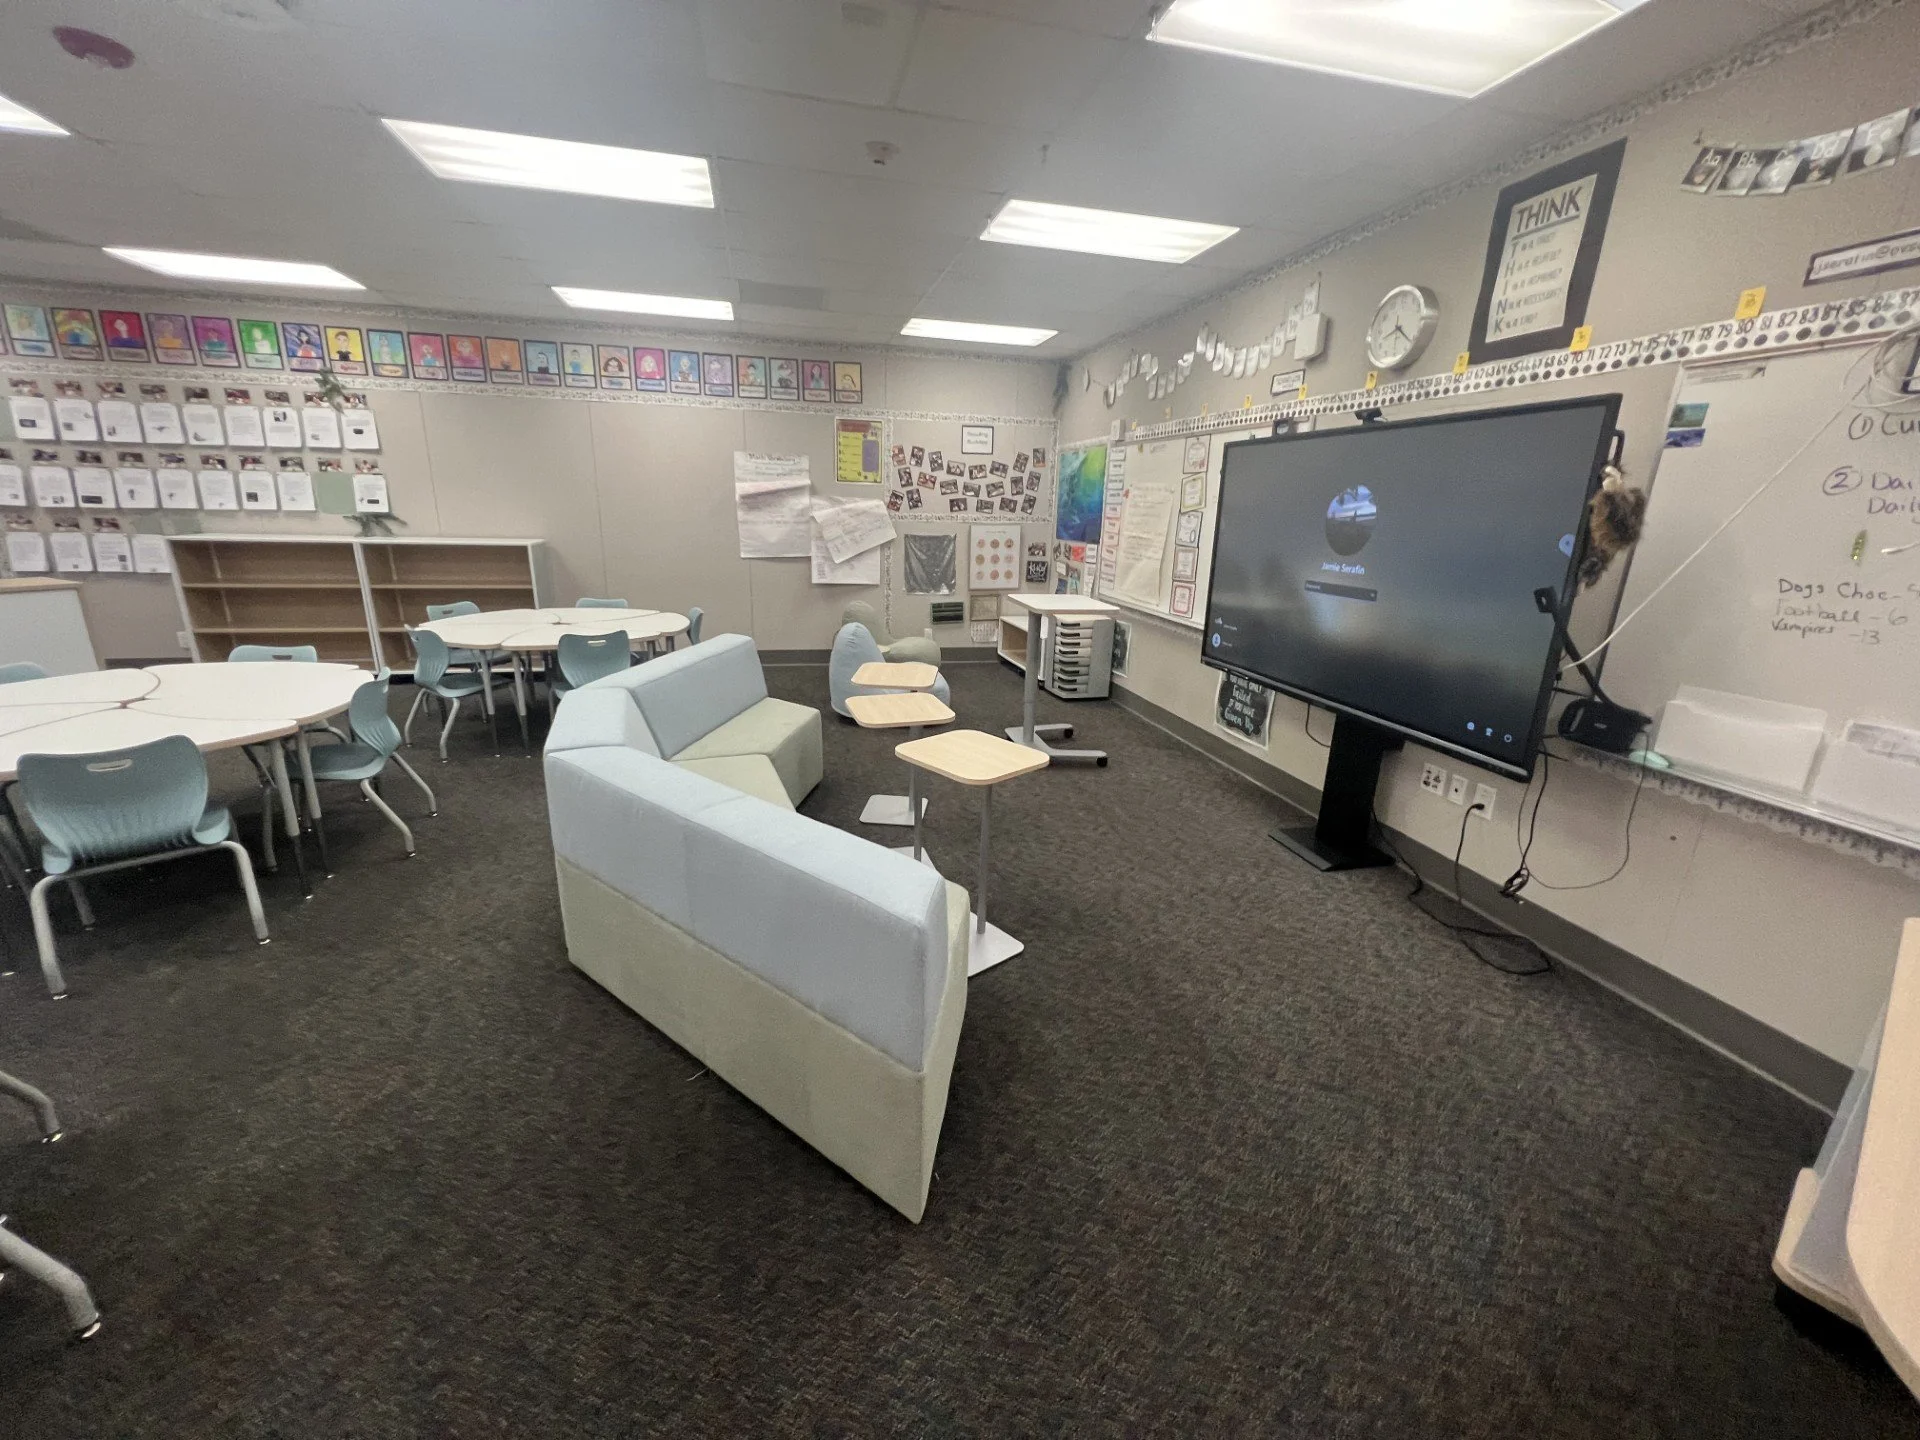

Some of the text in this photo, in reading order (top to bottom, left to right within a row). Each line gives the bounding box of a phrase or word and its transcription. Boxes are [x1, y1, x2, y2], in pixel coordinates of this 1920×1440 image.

[1702, 149, 1721, 166] Aa
[1738, 151, 1756, 169] Bb
[1810, 140, 1839, 161] Dd
[1516, 186, 1582, 233] THINK
[1504, 259, 1515, 278] H
[1496, 298, 1508, 316] N
[1494, 317, 1505, 335] K
[1544, 355, 1556, 368] 68
[1557, 353, 1569, 366] 69
[1586, 348, 1595, 361] 71
[1600, 345, 1612, 359] 72
[1614, 343, 1627, 356] 73
[1682, 330, 1696, 344] 77
[1700, 325, 1714, 341] 78
[1718, 323, 1733, 338] 79
[1736, 318, 1755, 335] 80
[1760, 315, 1773, 331] 81
[1777, 311, 1797, 328] 82
[1799, 307, 1820, 324] 83
[1881, 413, 1920, 436] Cu
[1321, 562, 1365, 575] Jamie Serafin
[1779, 578, 1825, 599] Dogs
